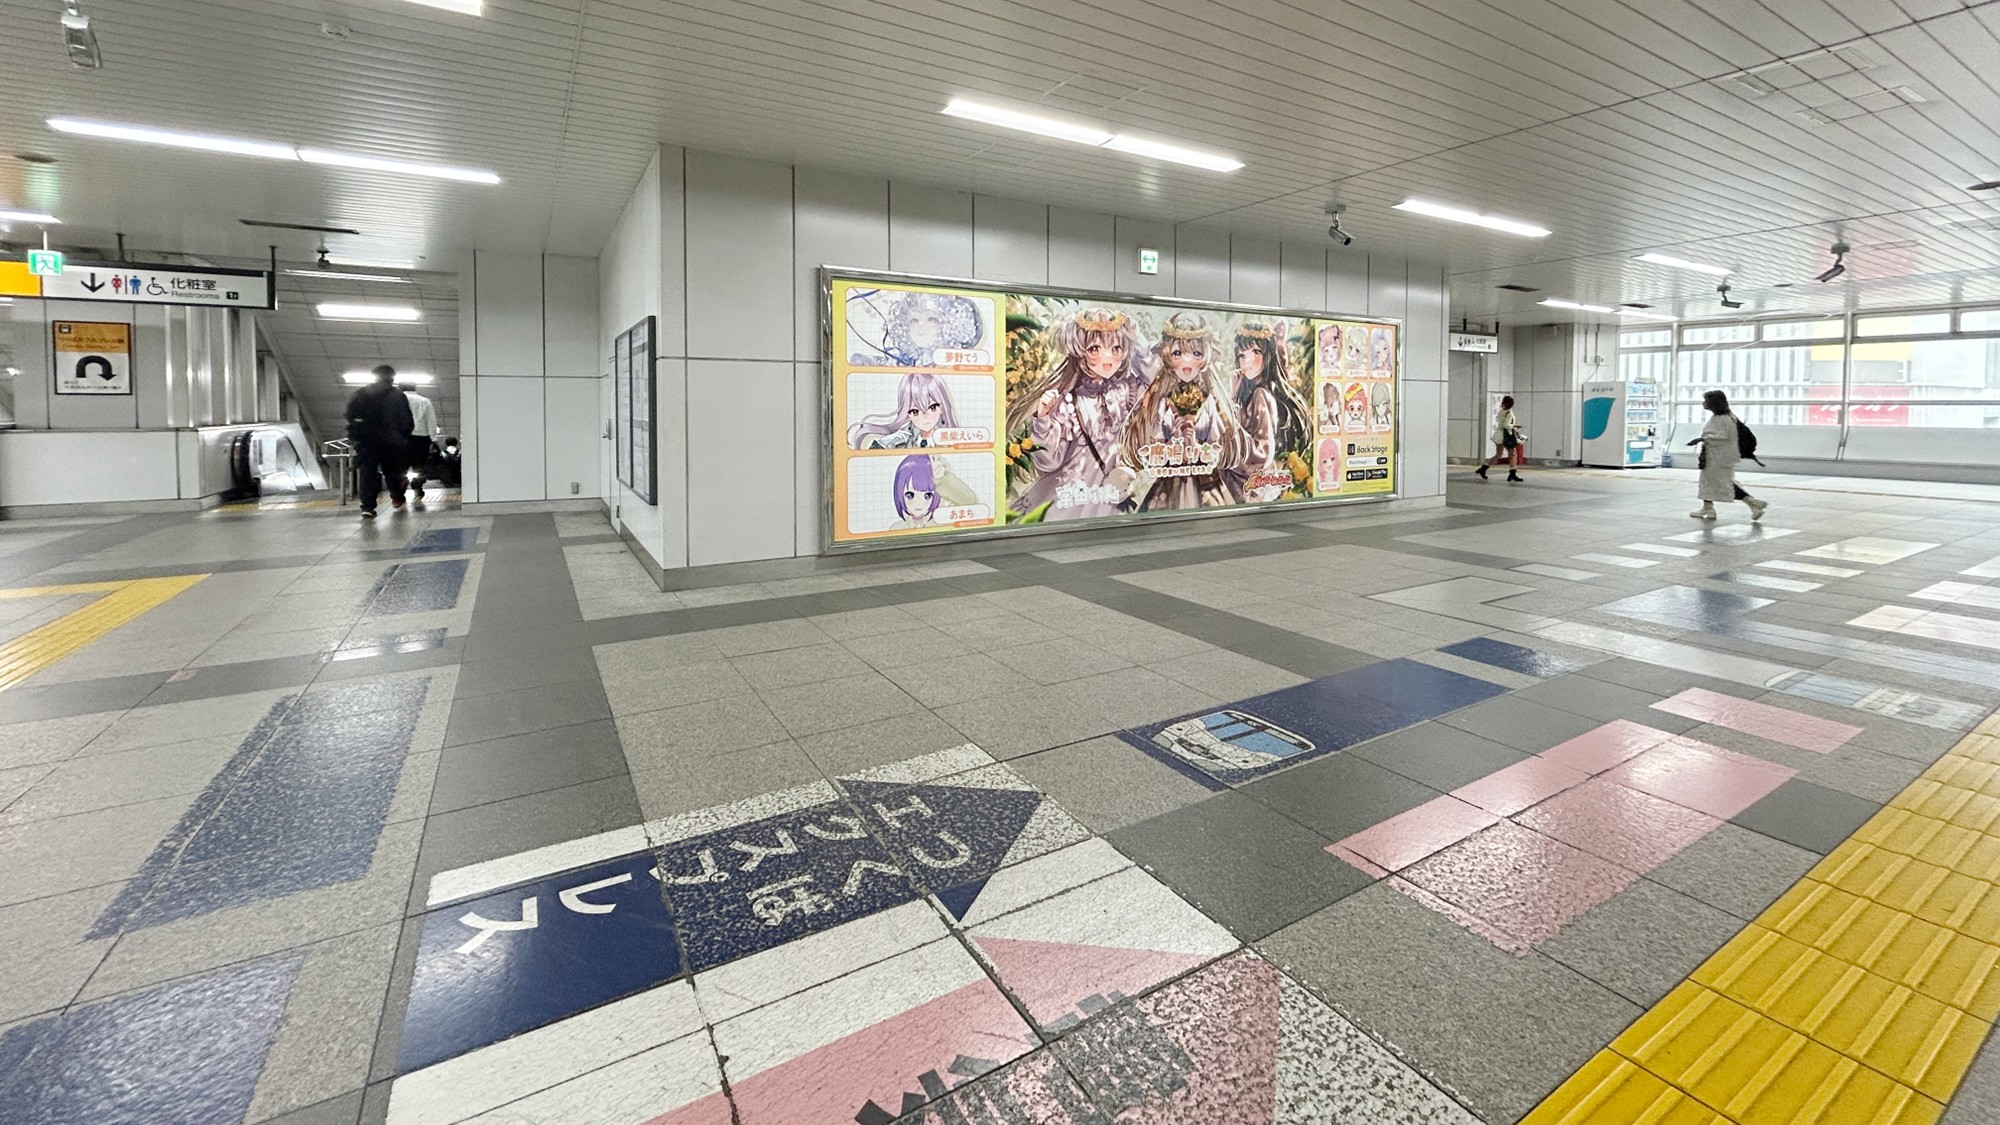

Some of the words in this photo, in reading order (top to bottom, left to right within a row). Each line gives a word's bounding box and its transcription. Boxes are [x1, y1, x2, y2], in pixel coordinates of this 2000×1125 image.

[171, 278, 216, 290] 化粧室
[171, 290, 220, 299] Restrooms
[940, 430, 984, 442] 黒柴えいら
[1357, 445, 1371, 454] Back
[1372, 445, 1388, 454] Stage
[949, 509, 974, 519] あまち
[454, 795, 936, 955] エクスプレス
[745, 829, 972, 927] つくば
